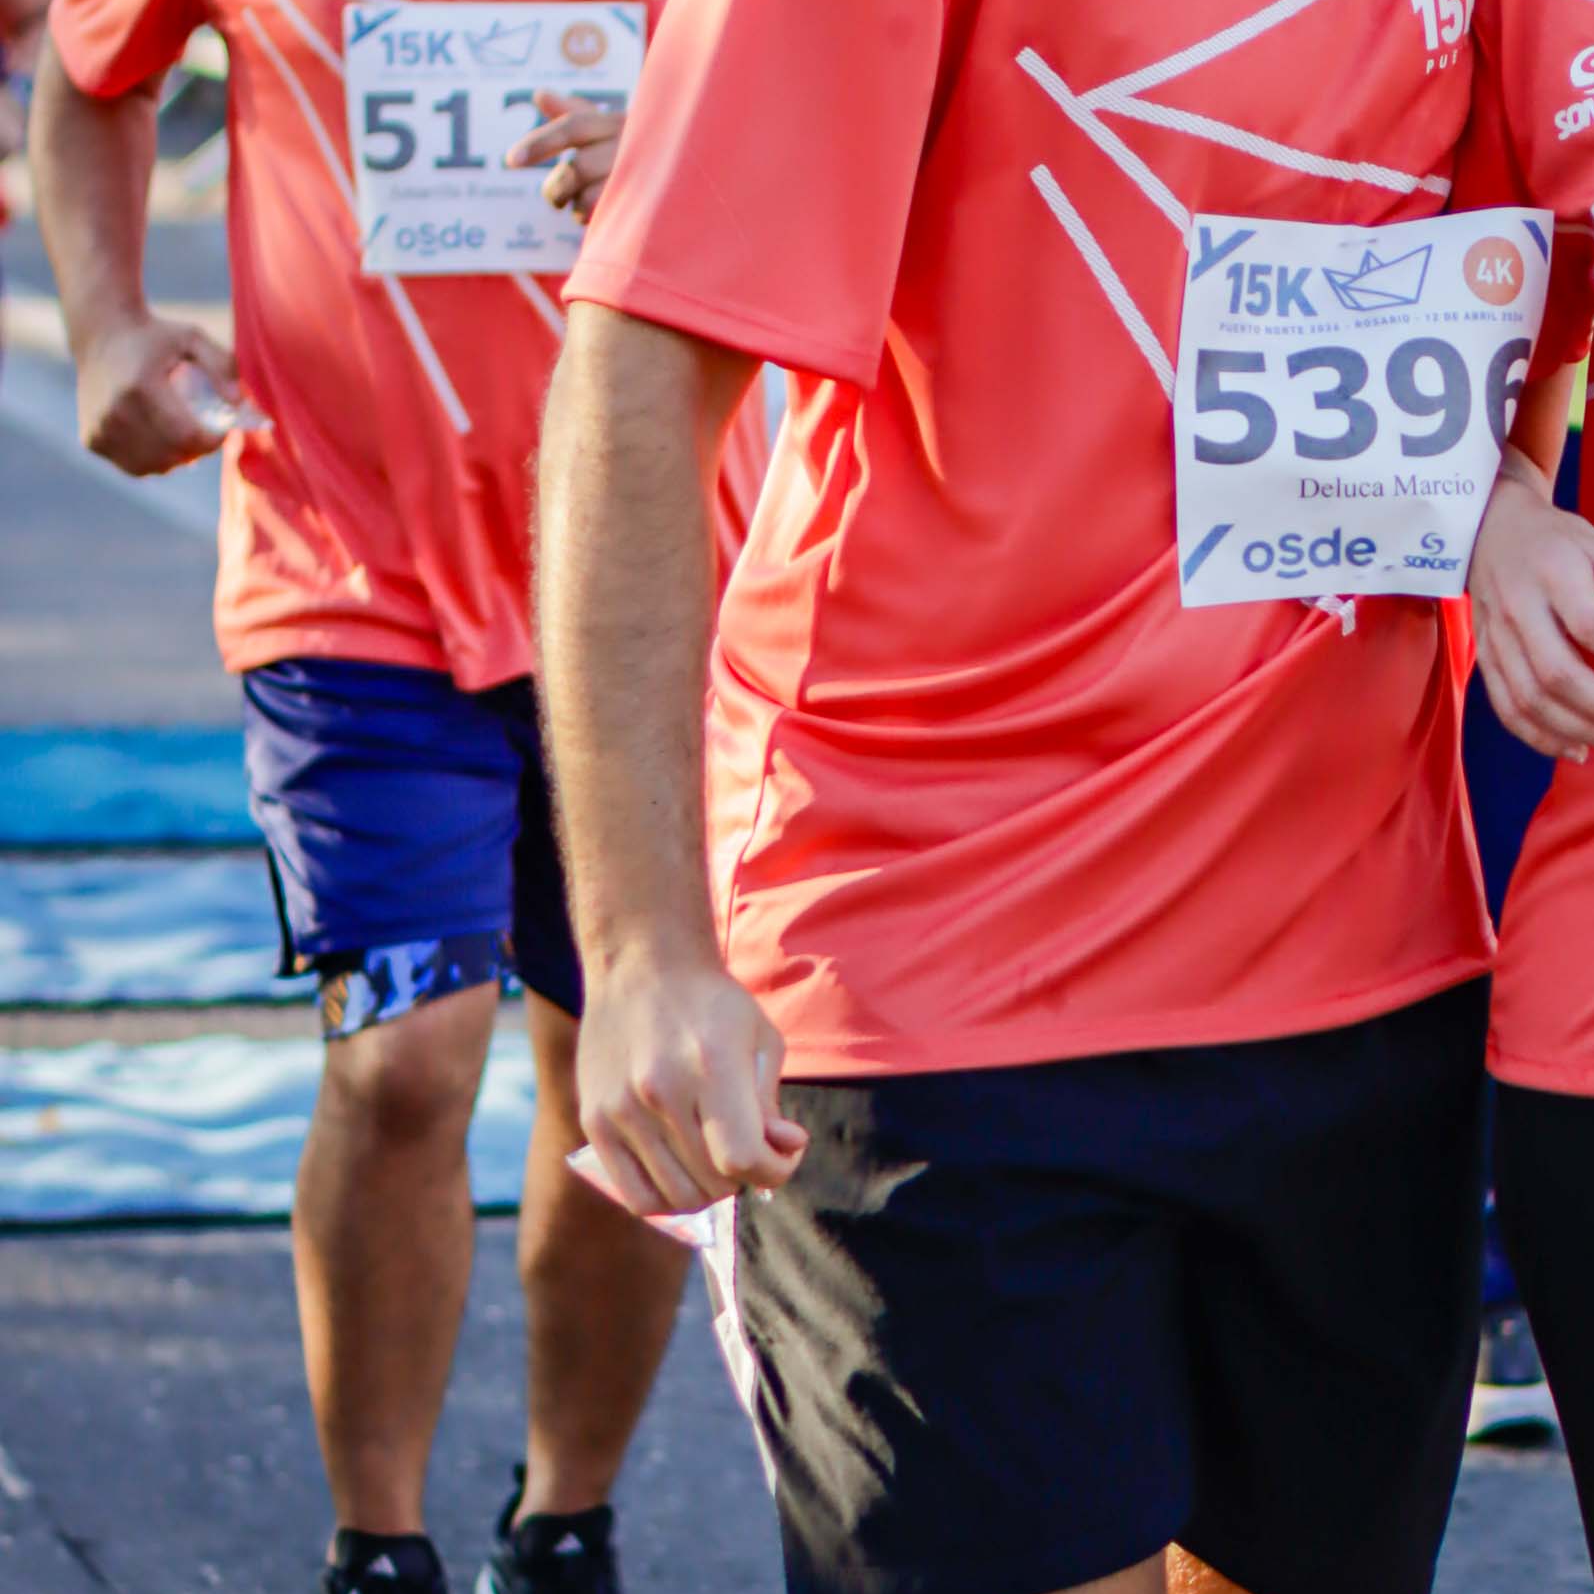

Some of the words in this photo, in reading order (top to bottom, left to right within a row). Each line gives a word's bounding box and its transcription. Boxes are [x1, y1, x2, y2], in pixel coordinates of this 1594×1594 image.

[379, 30, 454, 66] 15K
[1225, 262, 1318, 317] 15K
[1475, 257, 1515, 285] 4K
[1193, 336, 1533, 465] 5396
[1299, 476, 1385, 499] Deluca
[1393, 472, 1475, 497] Marcio
[1242, 526, 1377, 579] osde
